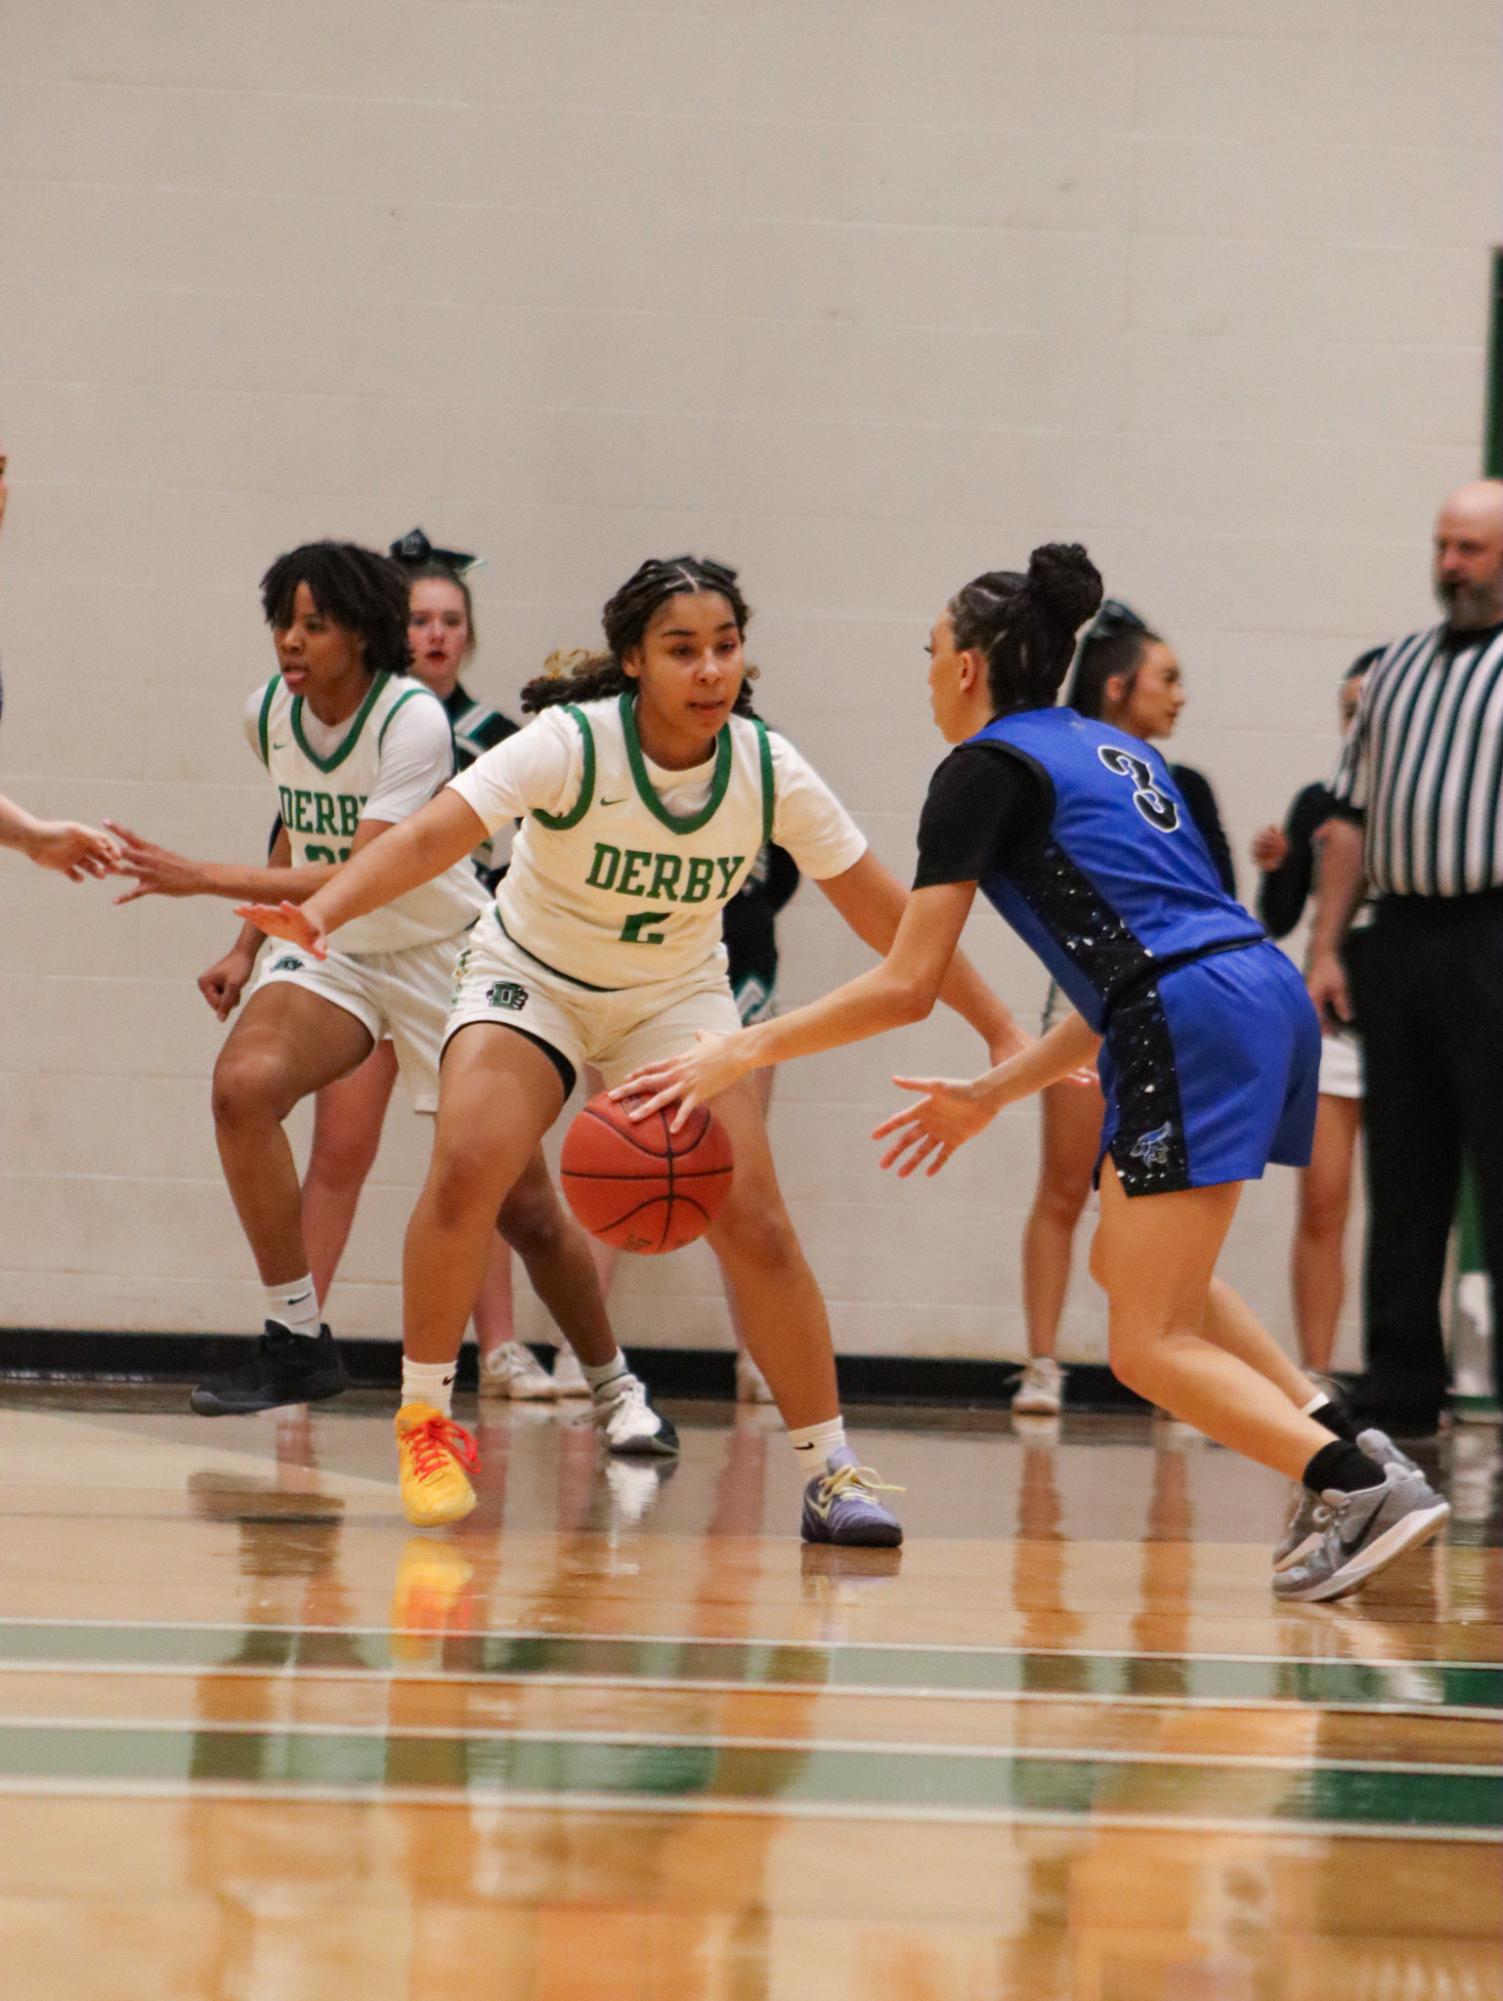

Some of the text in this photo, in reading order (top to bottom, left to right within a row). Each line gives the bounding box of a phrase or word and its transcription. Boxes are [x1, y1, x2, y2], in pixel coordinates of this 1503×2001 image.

[279, 786, 368, 837] DERB
[1097, 745, 1180, 832] 3
[585, 842, 745, 903] DERBY
